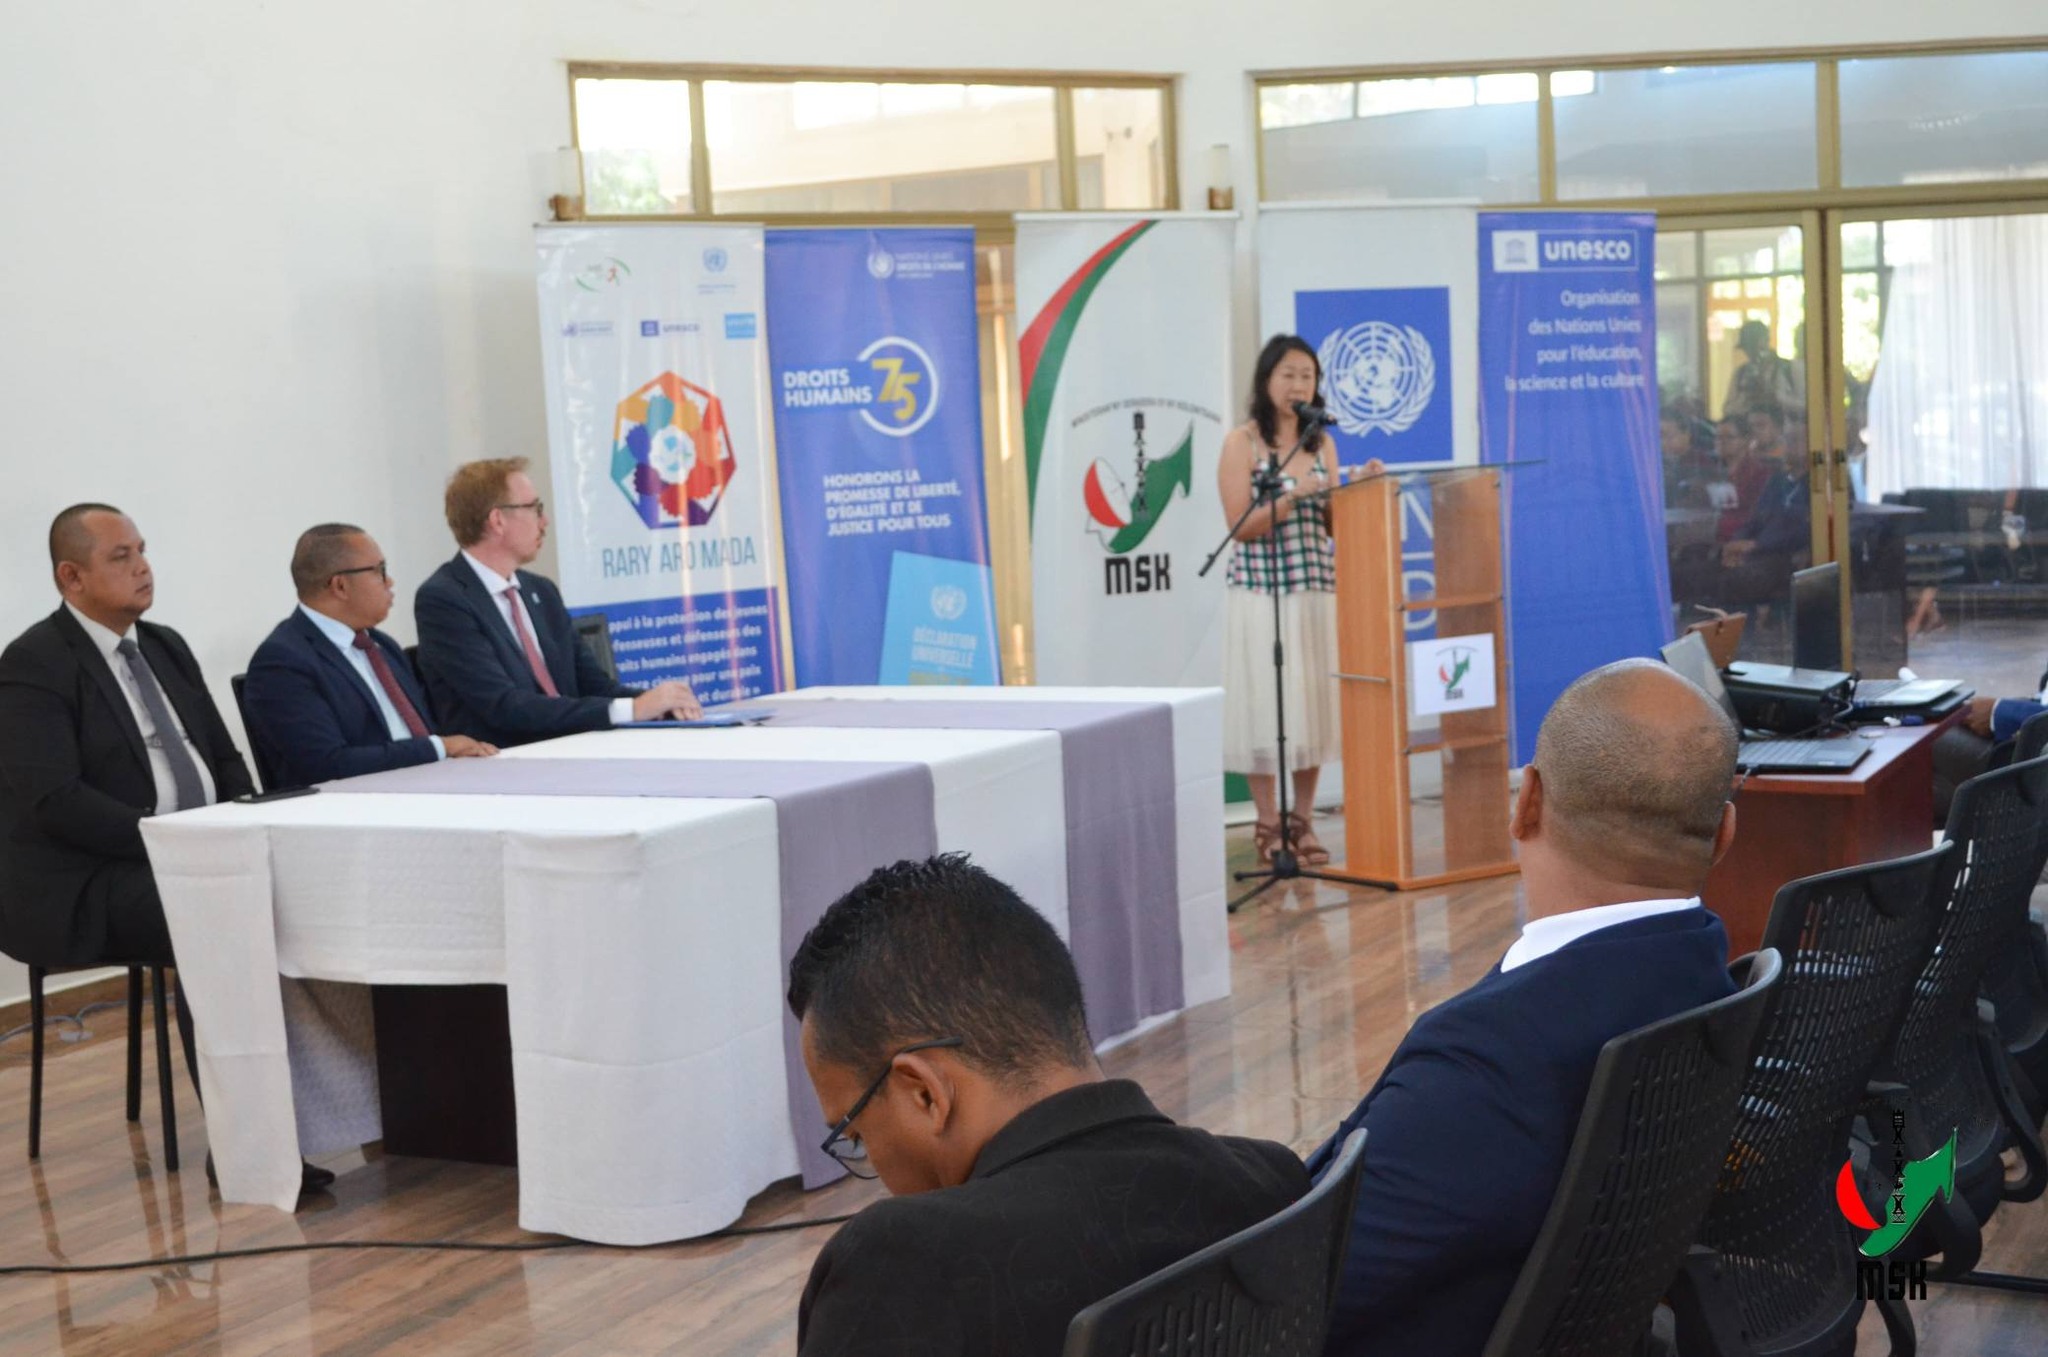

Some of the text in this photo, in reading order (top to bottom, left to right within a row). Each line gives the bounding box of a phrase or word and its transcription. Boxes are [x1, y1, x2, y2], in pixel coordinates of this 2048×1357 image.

[1544, 239, 1631, 261] unesco
[1560, 289, 1640, 309] Organisation
[1528, 316, 1642, 335] des Nations Unies
[1537, 349, 1568, 364] pour
[783, 368, 850, 388] DROITS
[1504, 371, 1645, 391] la science et la culture
[784, 386, 873, 408] HUMAINS
[871, 358, 921, 420] 75
[823, 469, 921, 488] HONORONS LA
[825, 486, 891, 504] PROMESSE
[894, 485, 910, 499] DE
[891, 501, 905, 514] ET
[908, 500, 923, 514] DE
[828, 513, 952, 537] JUSTICE POUR TOUS
[602, 546, 652, 578] RARY
[701, 536, 757, 569] MADA
[1104, 553, 1171, 595] MSK
[641, 614, 653, 628] la
[670, 633, 682, 646] et
[742, 624, 762, 637] des
[641, 653, 686, 669] humains
[692, 671, 716, 686] pour
[740, 663, 762, 679] paix
